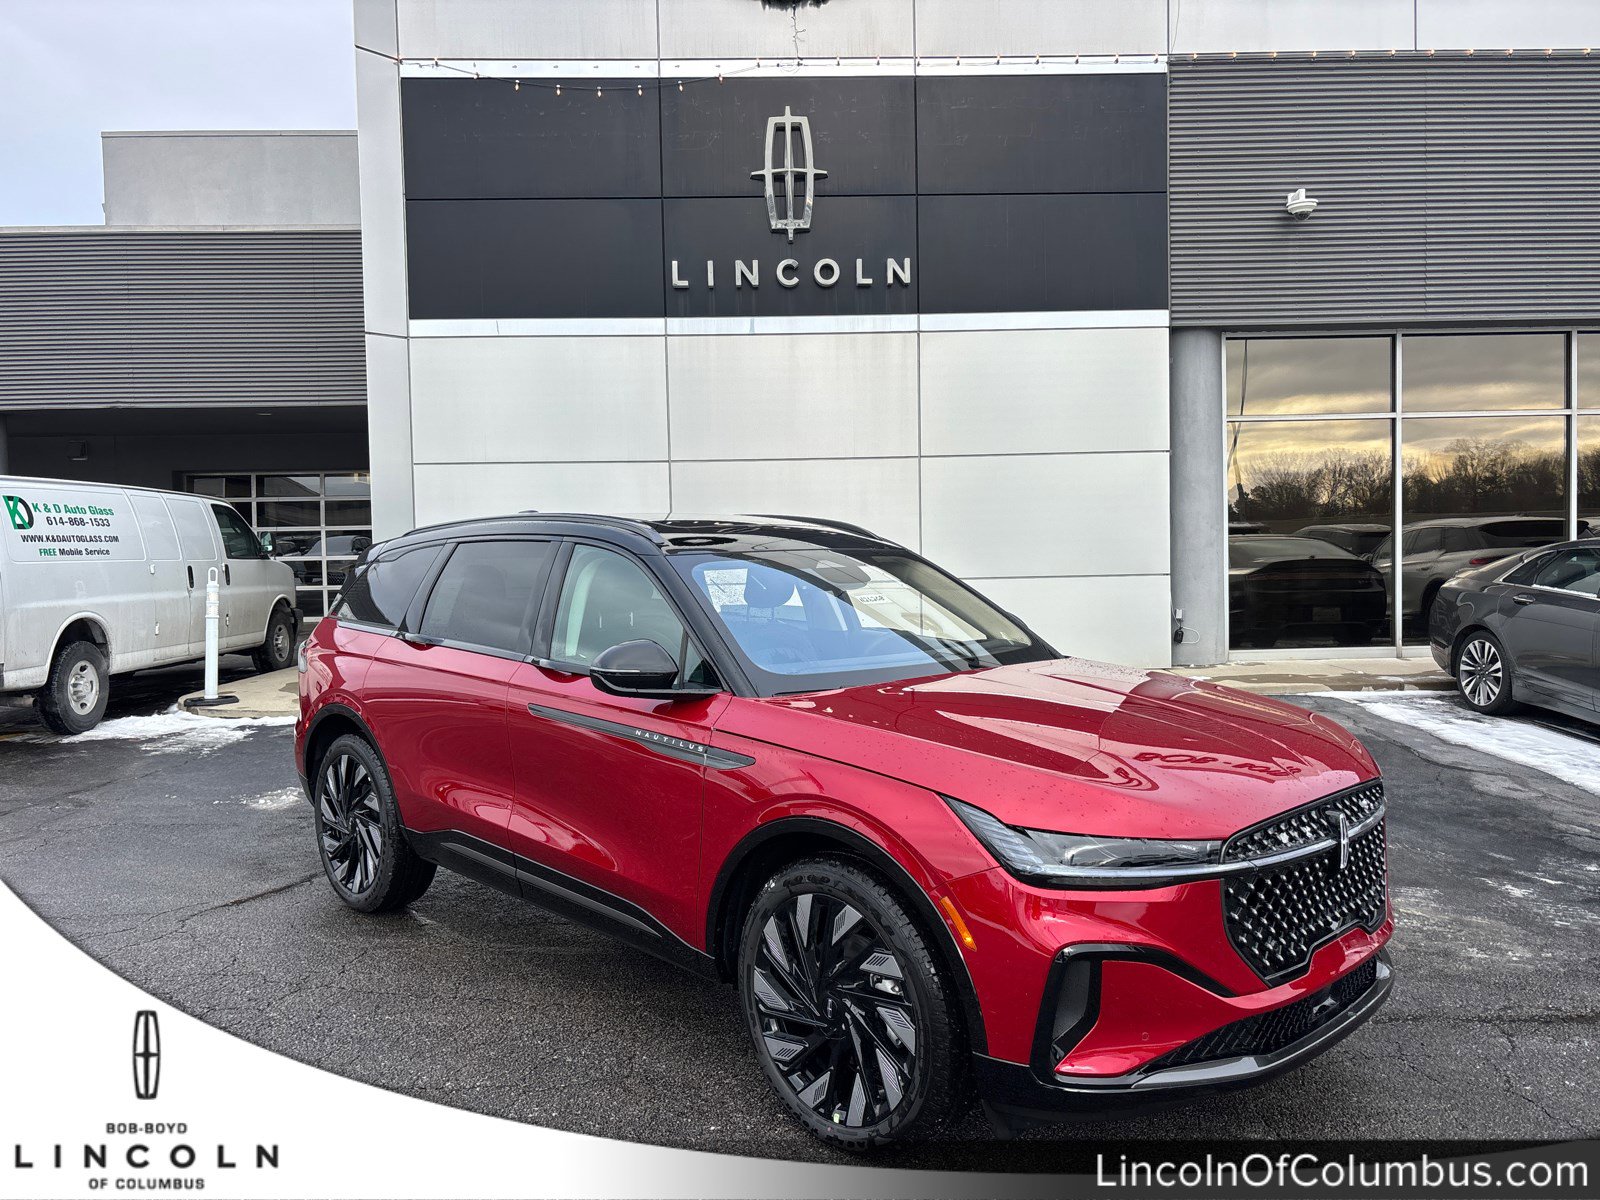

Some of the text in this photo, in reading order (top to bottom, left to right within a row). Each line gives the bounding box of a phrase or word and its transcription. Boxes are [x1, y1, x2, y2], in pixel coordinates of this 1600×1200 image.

[671, 258, 911, 289] LINCOLN
[31, 502, 115, 516] K & D Auto Glass
[45, 516, 111, 527] 614-868-1533
[20, 534, 120, 543] WWW.K&DAUTOGLASS.COM
[39, 548, 111, 557] FREE Mobile Service
[635, 730, 704, 752] NAUTILUS
